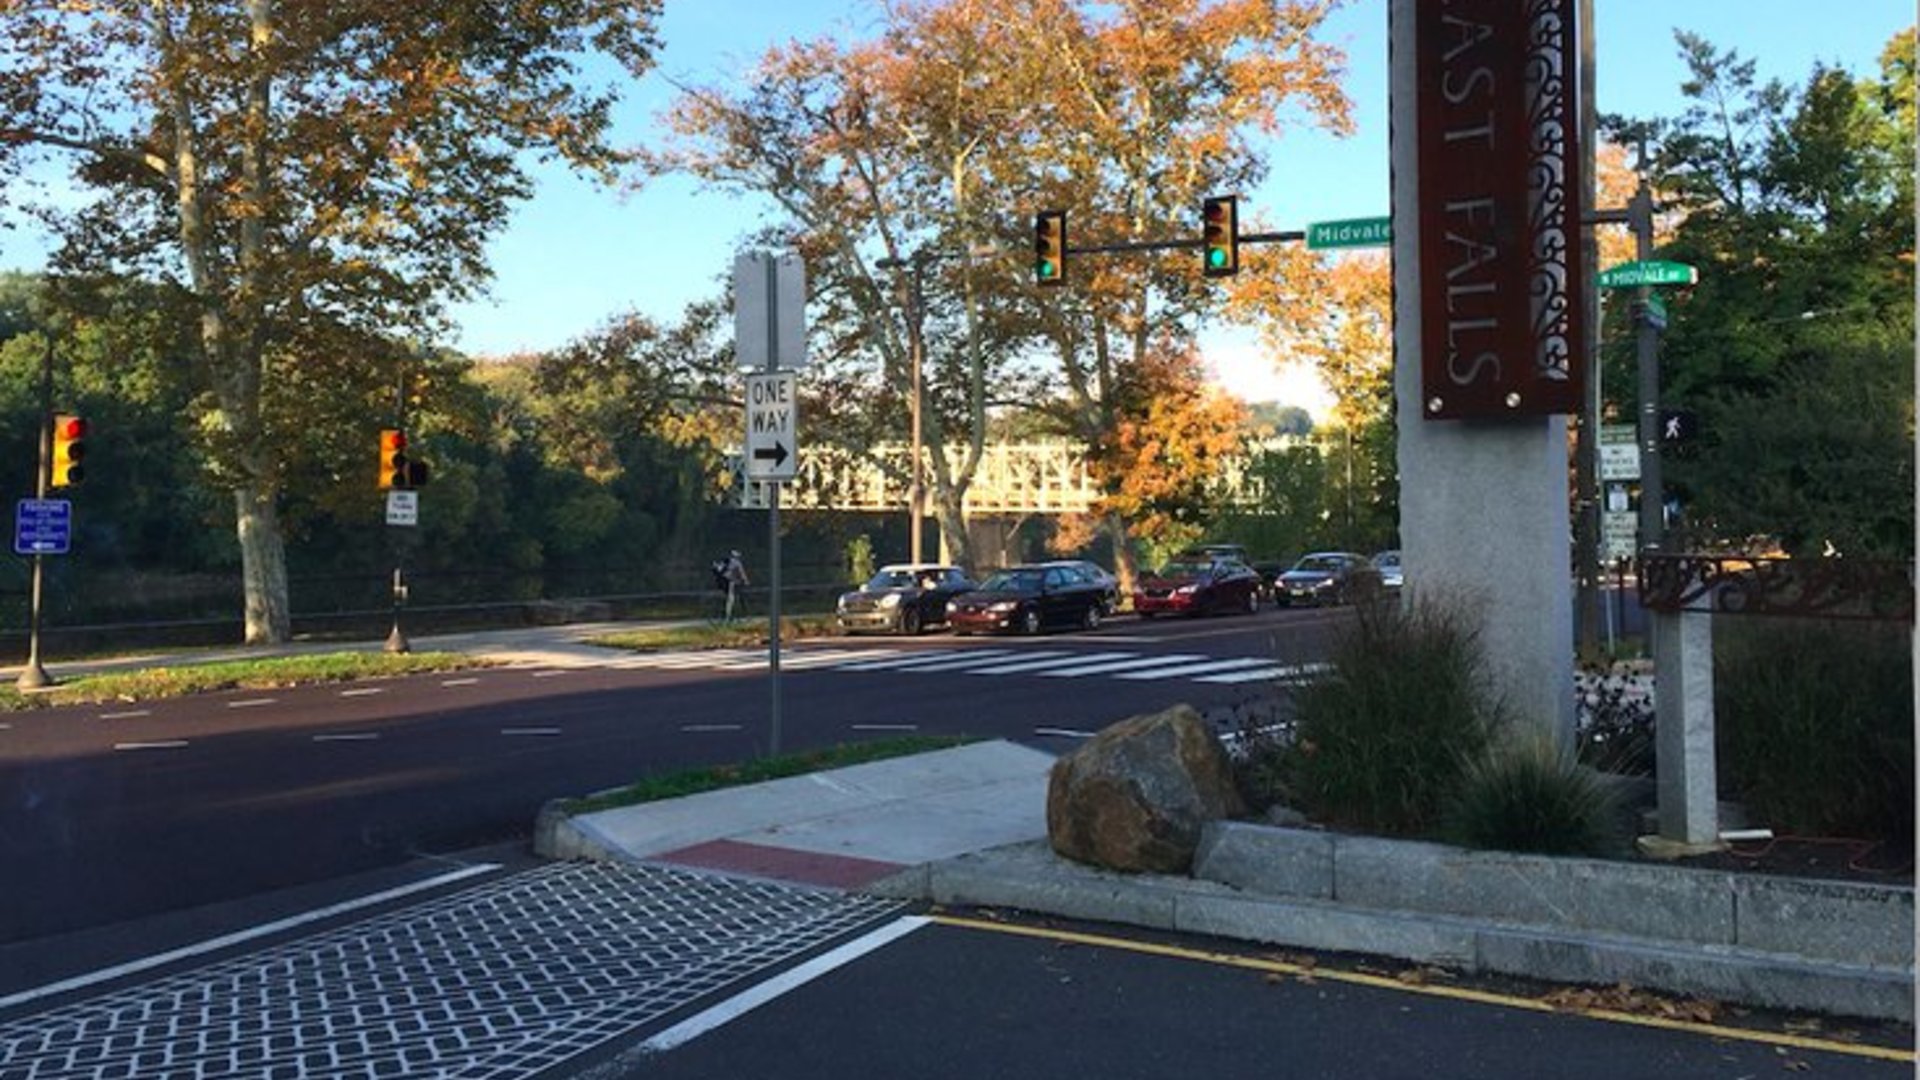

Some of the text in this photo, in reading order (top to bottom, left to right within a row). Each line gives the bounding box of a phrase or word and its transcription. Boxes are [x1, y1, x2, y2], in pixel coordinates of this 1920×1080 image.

[1441, 0, 1501, 386] AST FALLS
[1612, 267, 1666, 286] MIDVALE
[753, 380, 788, 405] ONE
[752, 409, 789, 433] WAY
